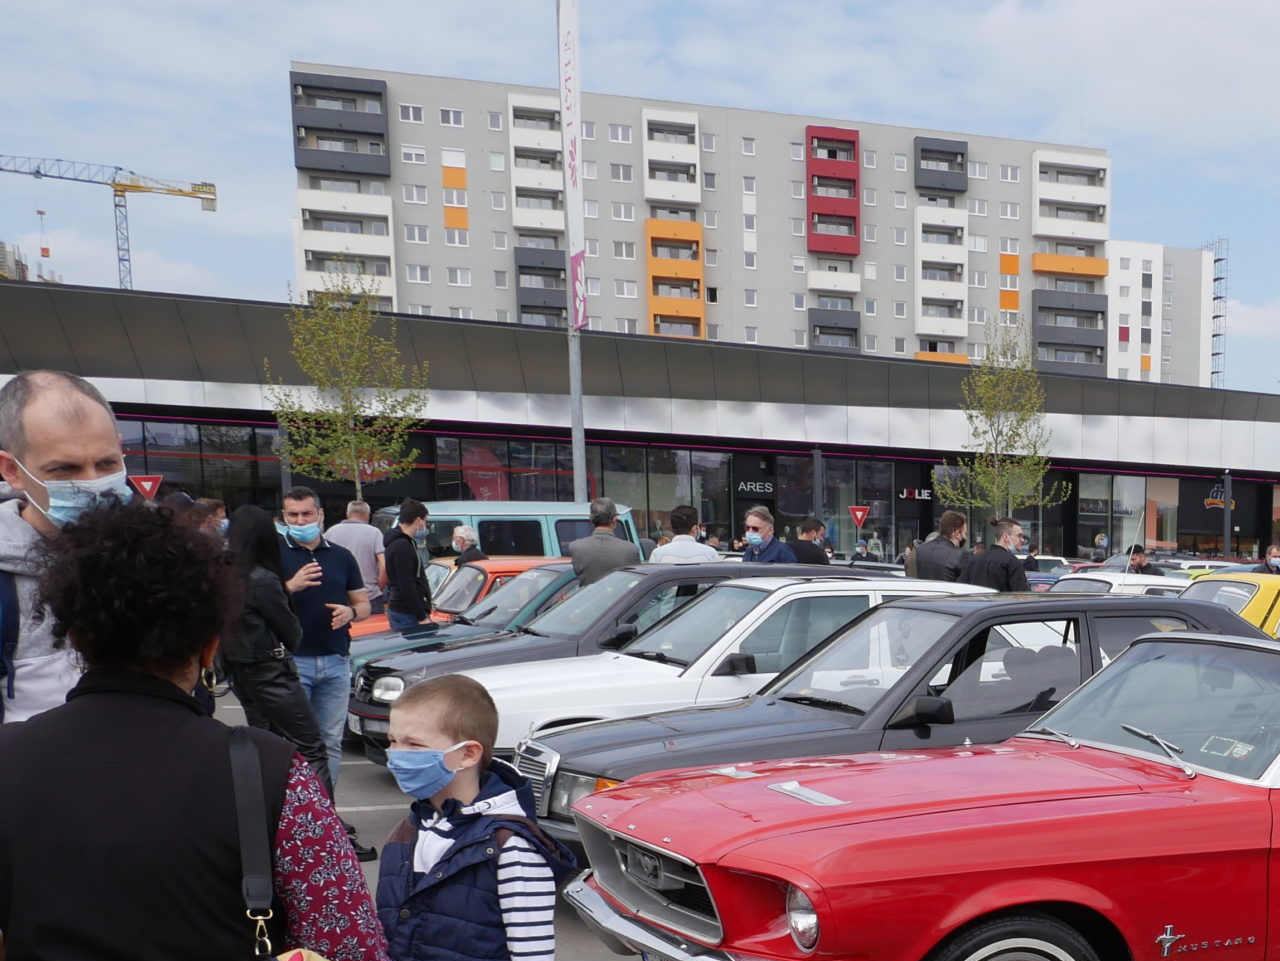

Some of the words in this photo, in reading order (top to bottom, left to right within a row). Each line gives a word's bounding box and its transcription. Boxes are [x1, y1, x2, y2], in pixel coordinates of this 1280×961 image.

[738, 481, 773, 493] ARES
[899, 488, 932, 500] JOLIE
[1178, 936, 1255, 952] MUSTANG
